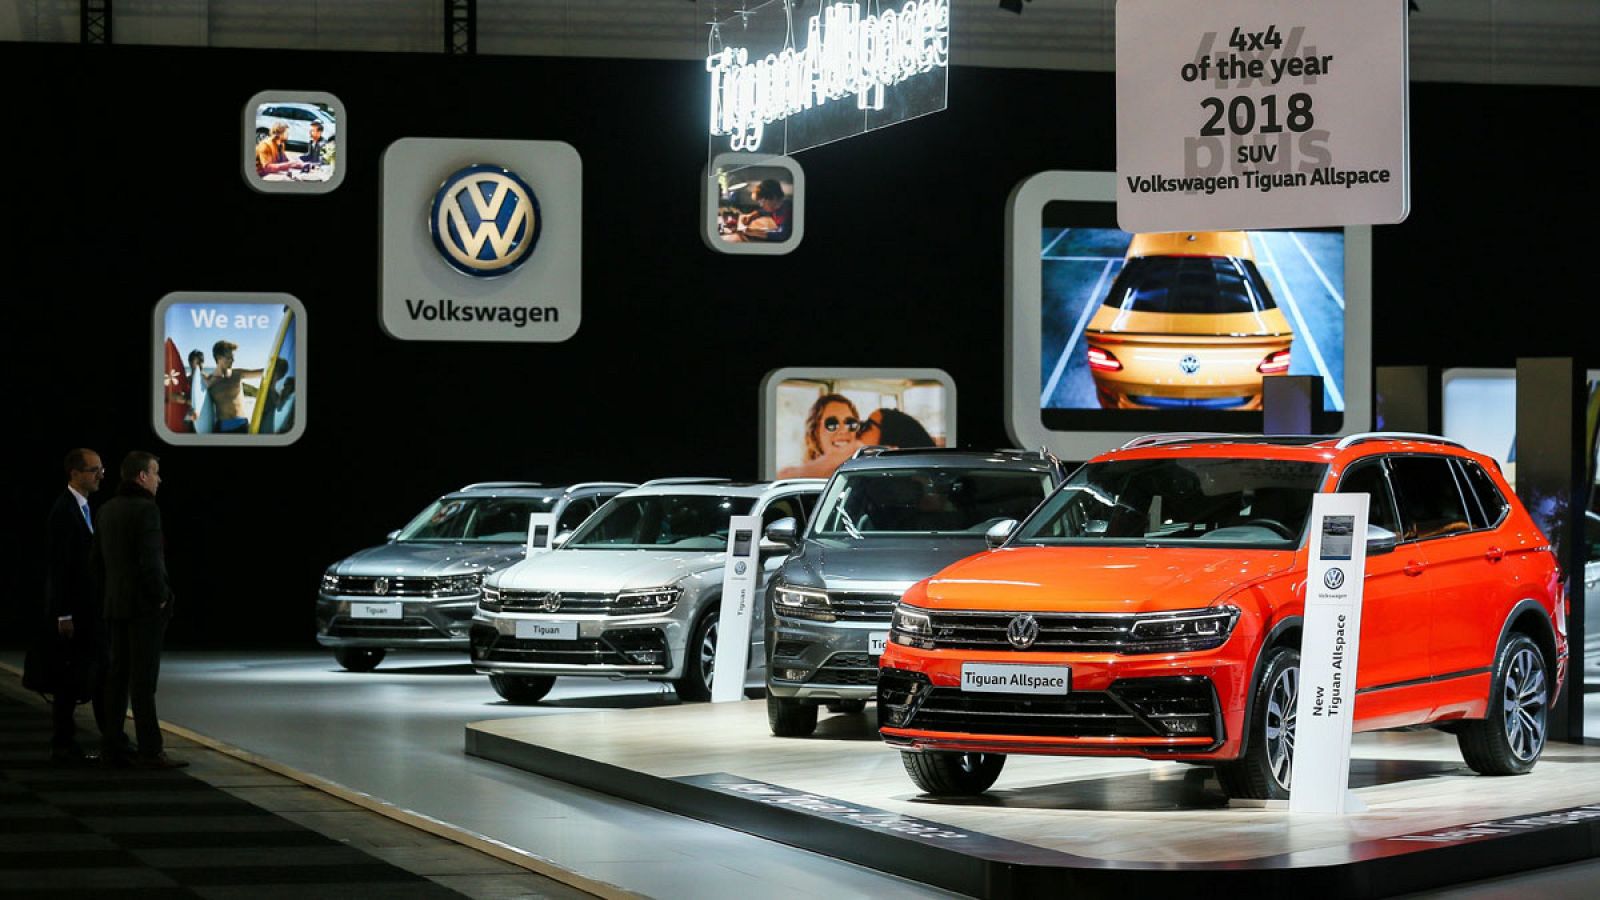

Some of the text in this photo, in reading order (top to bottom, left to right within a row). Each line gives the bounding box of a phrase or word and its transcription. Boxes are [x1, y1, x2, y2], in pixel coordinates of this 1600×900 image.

[1229, 25, 1282, 51] 4x4
[1181, 53, 1333, 84] of the year
[1200, 92, 1315, 137] 2018
[1237, 145, 1277, 163] SUV
[1127, 168, 1390, 194] Volkswagen Tiguan Allspace
[190, 308, 270, 329] We are
[405, 299, 559, 328] Volkswagen
[736, 588, 746, 617] Tiguan
[533, 625, 561, 636] Tiguan
[1328, 614, 1347, 716] Tiguan Allspace
[964, 671, 1064, 689] Tiguan Allspace
[1312, 686, 1325, 716] New
